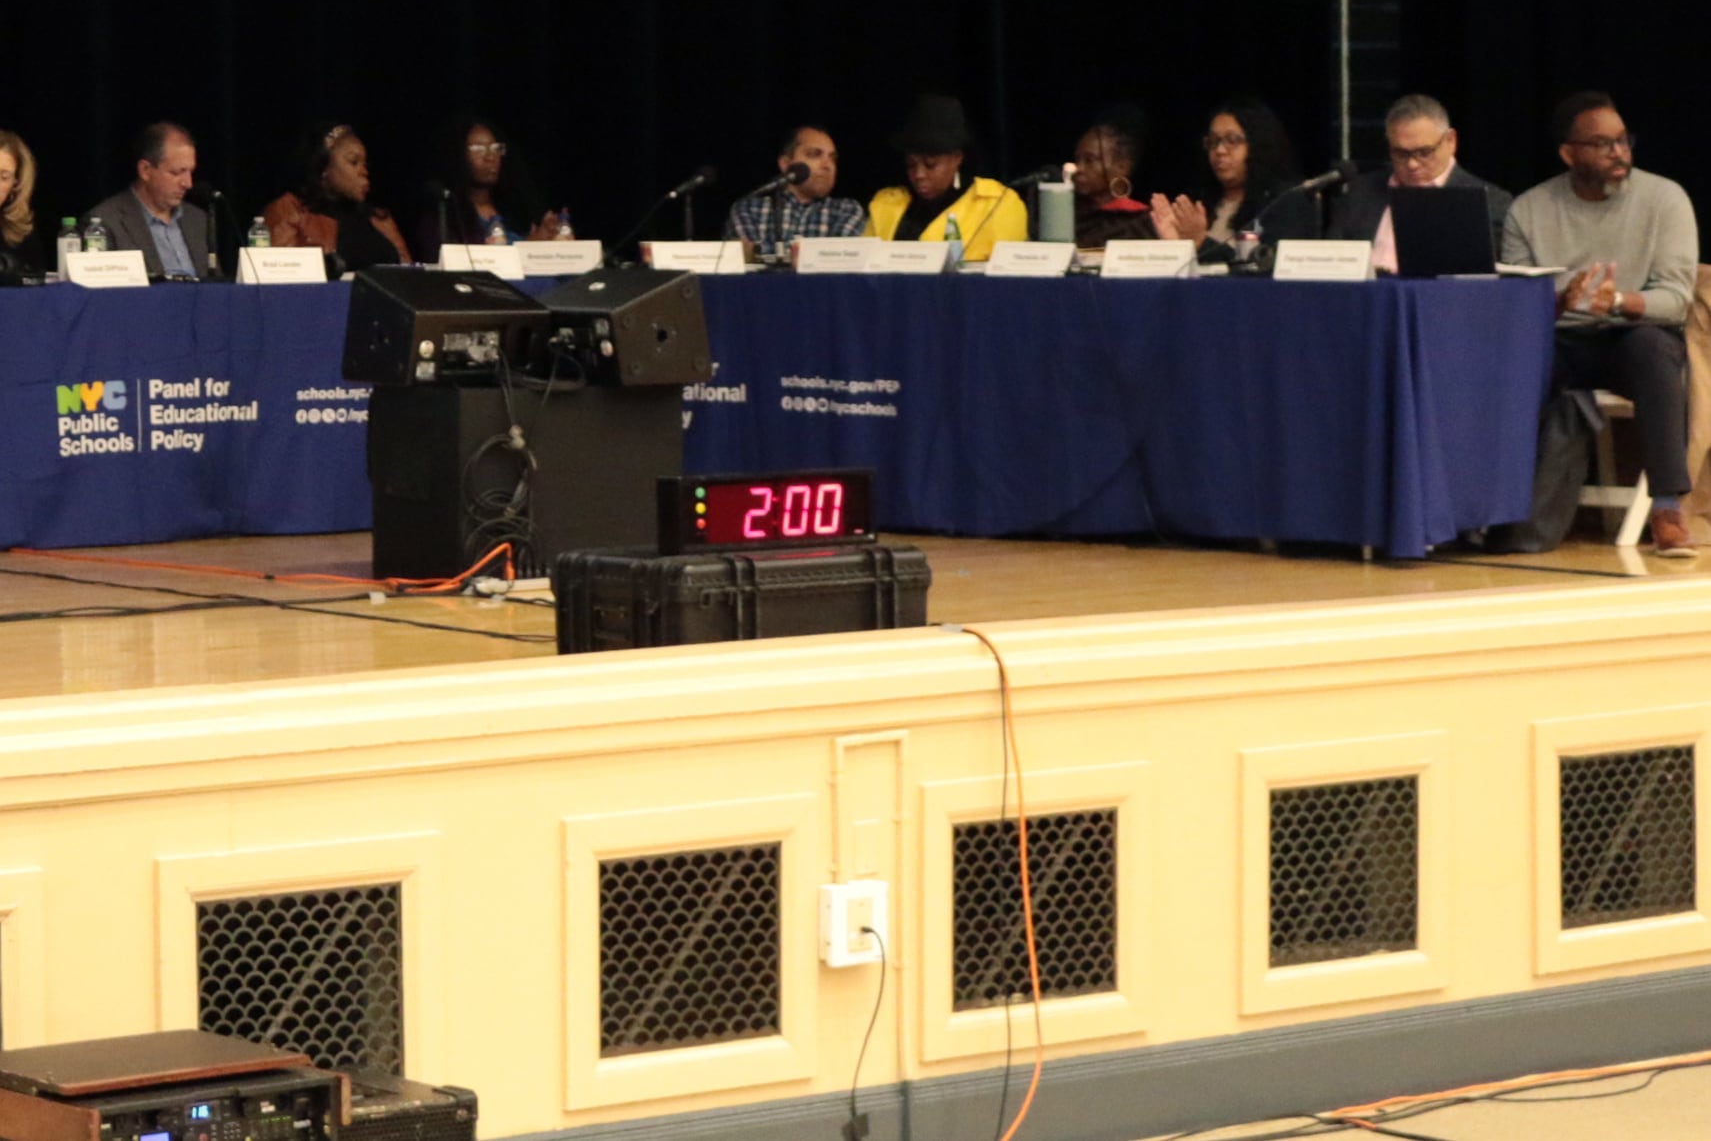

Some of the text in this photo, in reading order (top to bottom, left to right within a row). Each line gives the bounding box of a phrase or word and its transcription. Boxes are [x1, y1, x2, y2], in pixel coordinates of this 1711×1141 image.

[56, 380, 128, 415] NYC
[149, 377, 230, 399] Panel for
[682, 383, 747, 403] ational
[58, 414, 119, 436] Public
[150, 401, 258, 425] Educational
[59, 433, 135, 458] Schools
[151, 429, 204, 453] Policy
